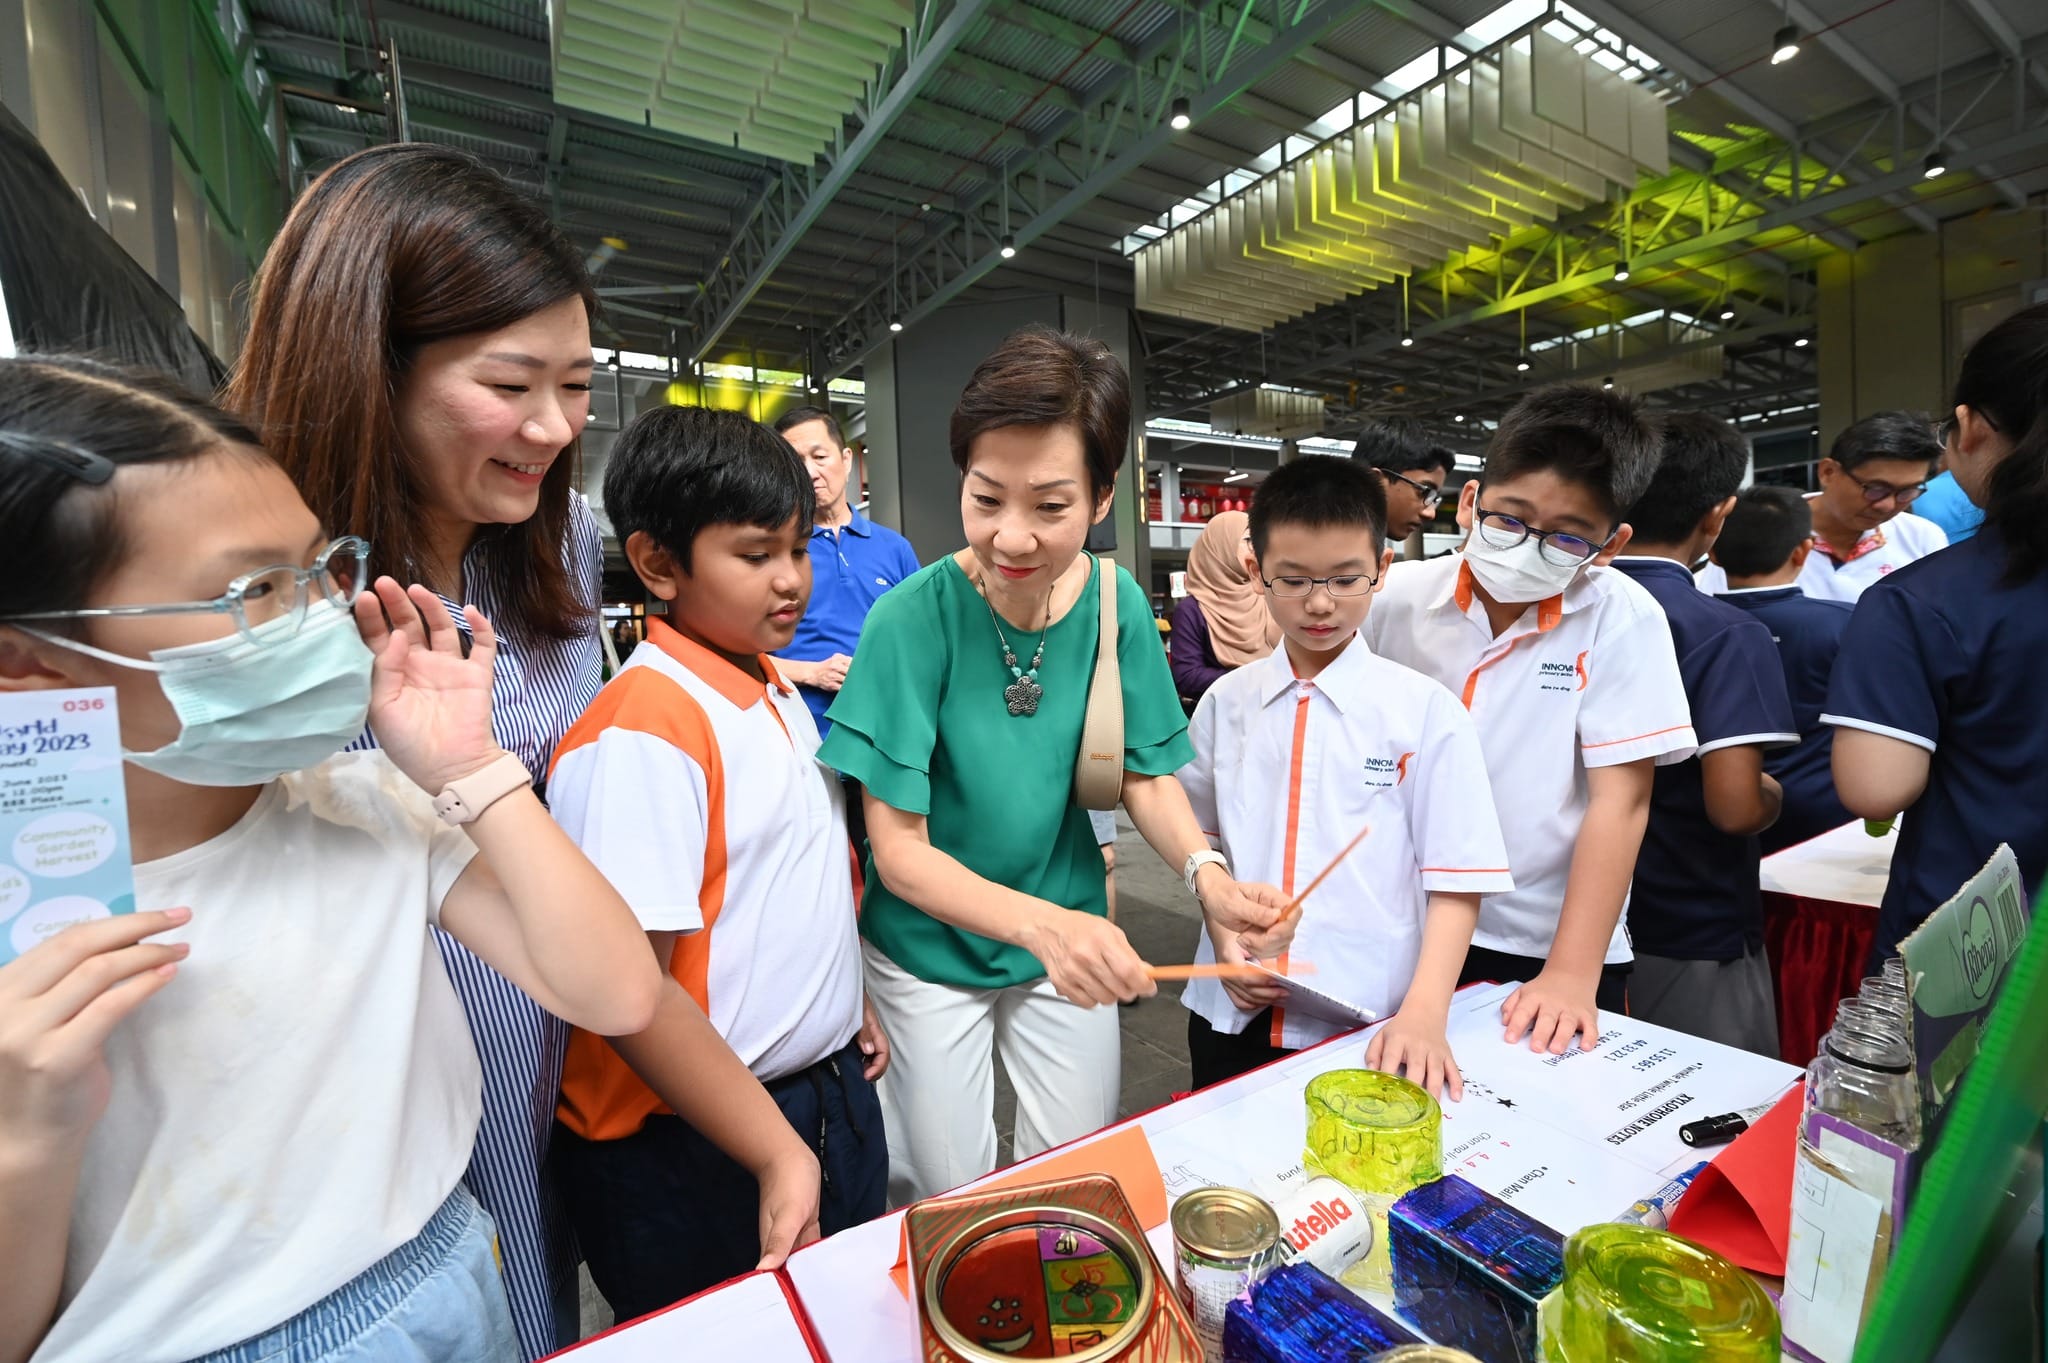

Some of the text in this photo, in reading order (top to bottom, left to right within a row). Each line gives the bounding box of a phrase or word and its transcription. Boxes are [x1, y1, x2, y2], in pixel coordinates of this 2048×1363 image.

[1541, 662, 1574, 672] INNOVA
[63, 698, 104, 712] 036
[0, 718, 57, 737] orld
[33, 733, 91, 754] 2023
[1365, 757, 1394, 767] INNOVA
[21, 824, 108, 844] Community
[36, 839, 97, 854] Garden
[34, 849, 98, 867] Harvest
[1967, 936, 1995, 986] Ribena
[1610, 1050, 1628, 1058] 22
[1621, 1044, 1638, 1052] 33
[1648, 1078, 1679, 1094] Twinkle
[1631, 1090, 1655, 1103] Little
[1617, 1100, 1637, 1112] Star
[1643, 1093, 1695, 1127] XYLOPHONE
[1469, 1131, 1492, 1146] Chan
[1606, 1119, 1645, 1146] NOTES
[1277, 1165, 1303, 1182] yung
[1498, 1168, 1545, 1200] Chan Mali
[1279, 1197, 1353, 1262] nutella
